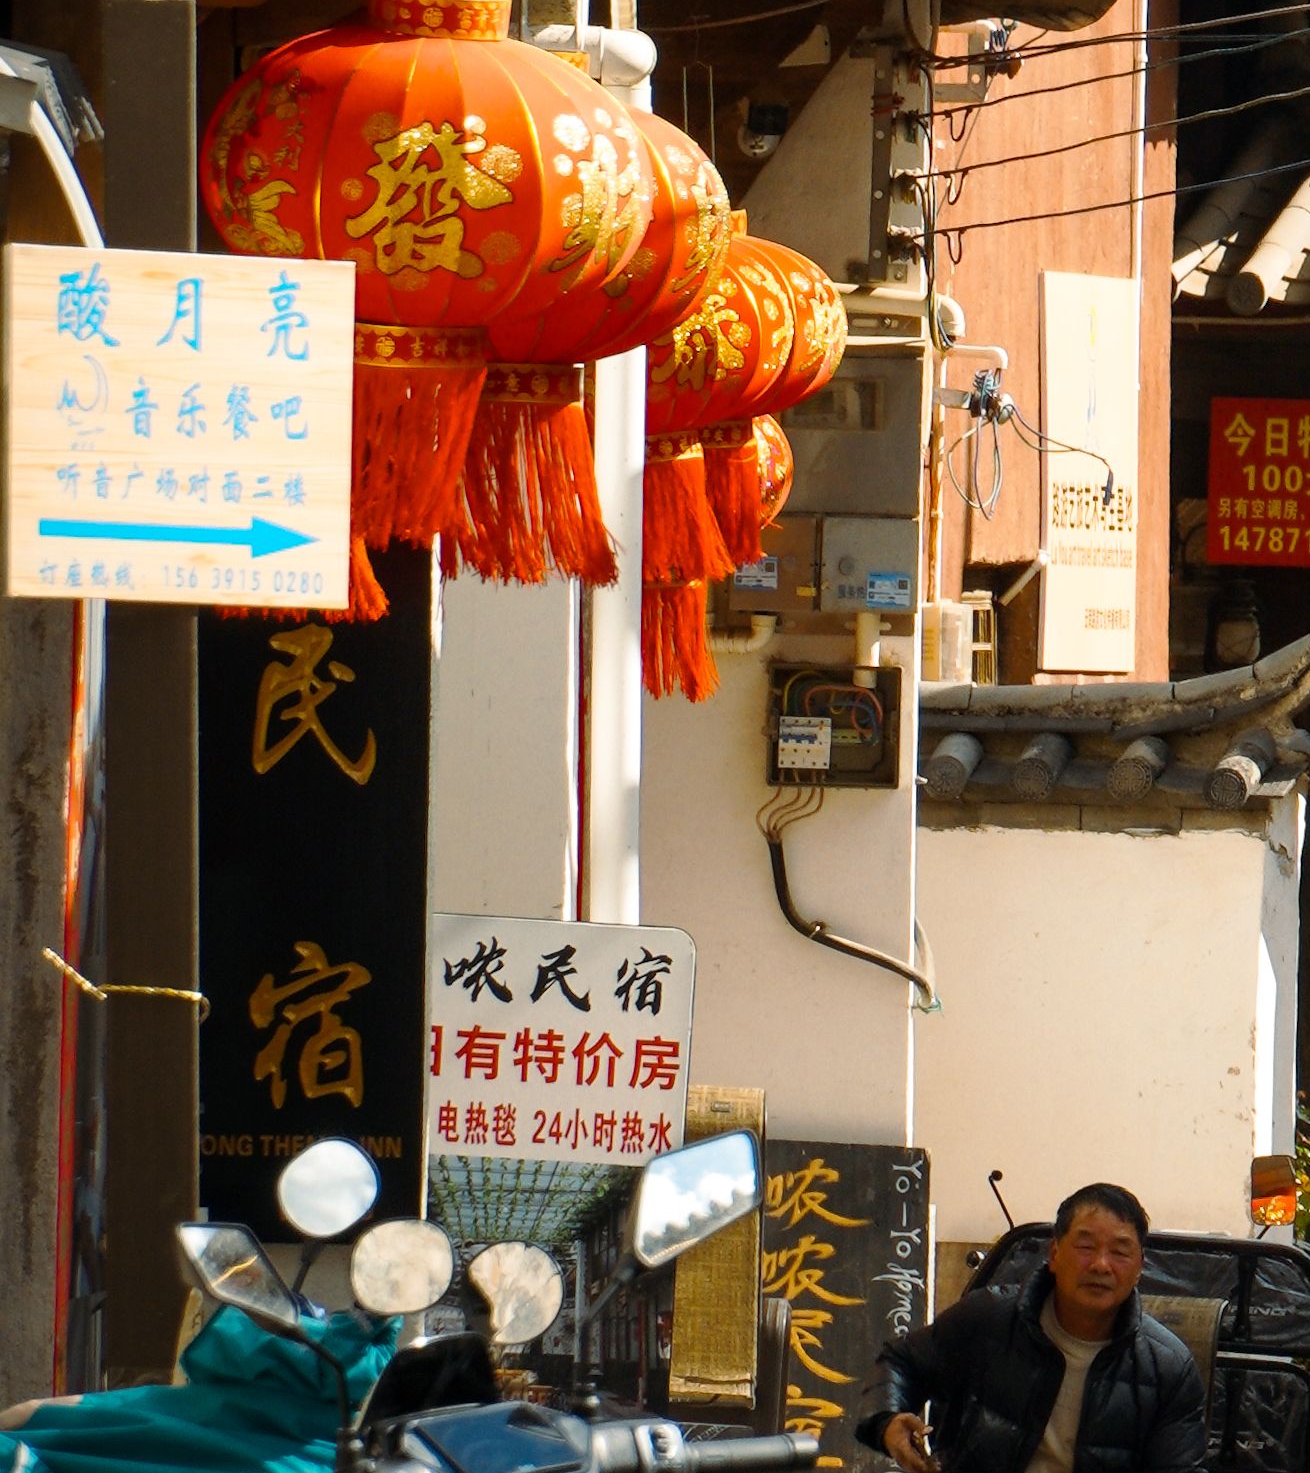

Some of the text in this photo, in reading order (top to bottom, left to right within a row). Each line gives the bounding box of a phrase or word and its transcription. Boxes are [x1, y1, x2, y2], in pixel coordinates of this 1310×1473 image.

[56, 262, 310, 362] 酸月亮
[125, 377, 310, 441] 音乐餐吧
[56, 462, 307, 507] 听音广场对面二楼
[164, 564, 199, 589] 156
[211, 566, 262, 592] 3915
[272, 571, 324, 595] 0280
[438, 1099, 673, 1155] 电热毯 24小时热水
